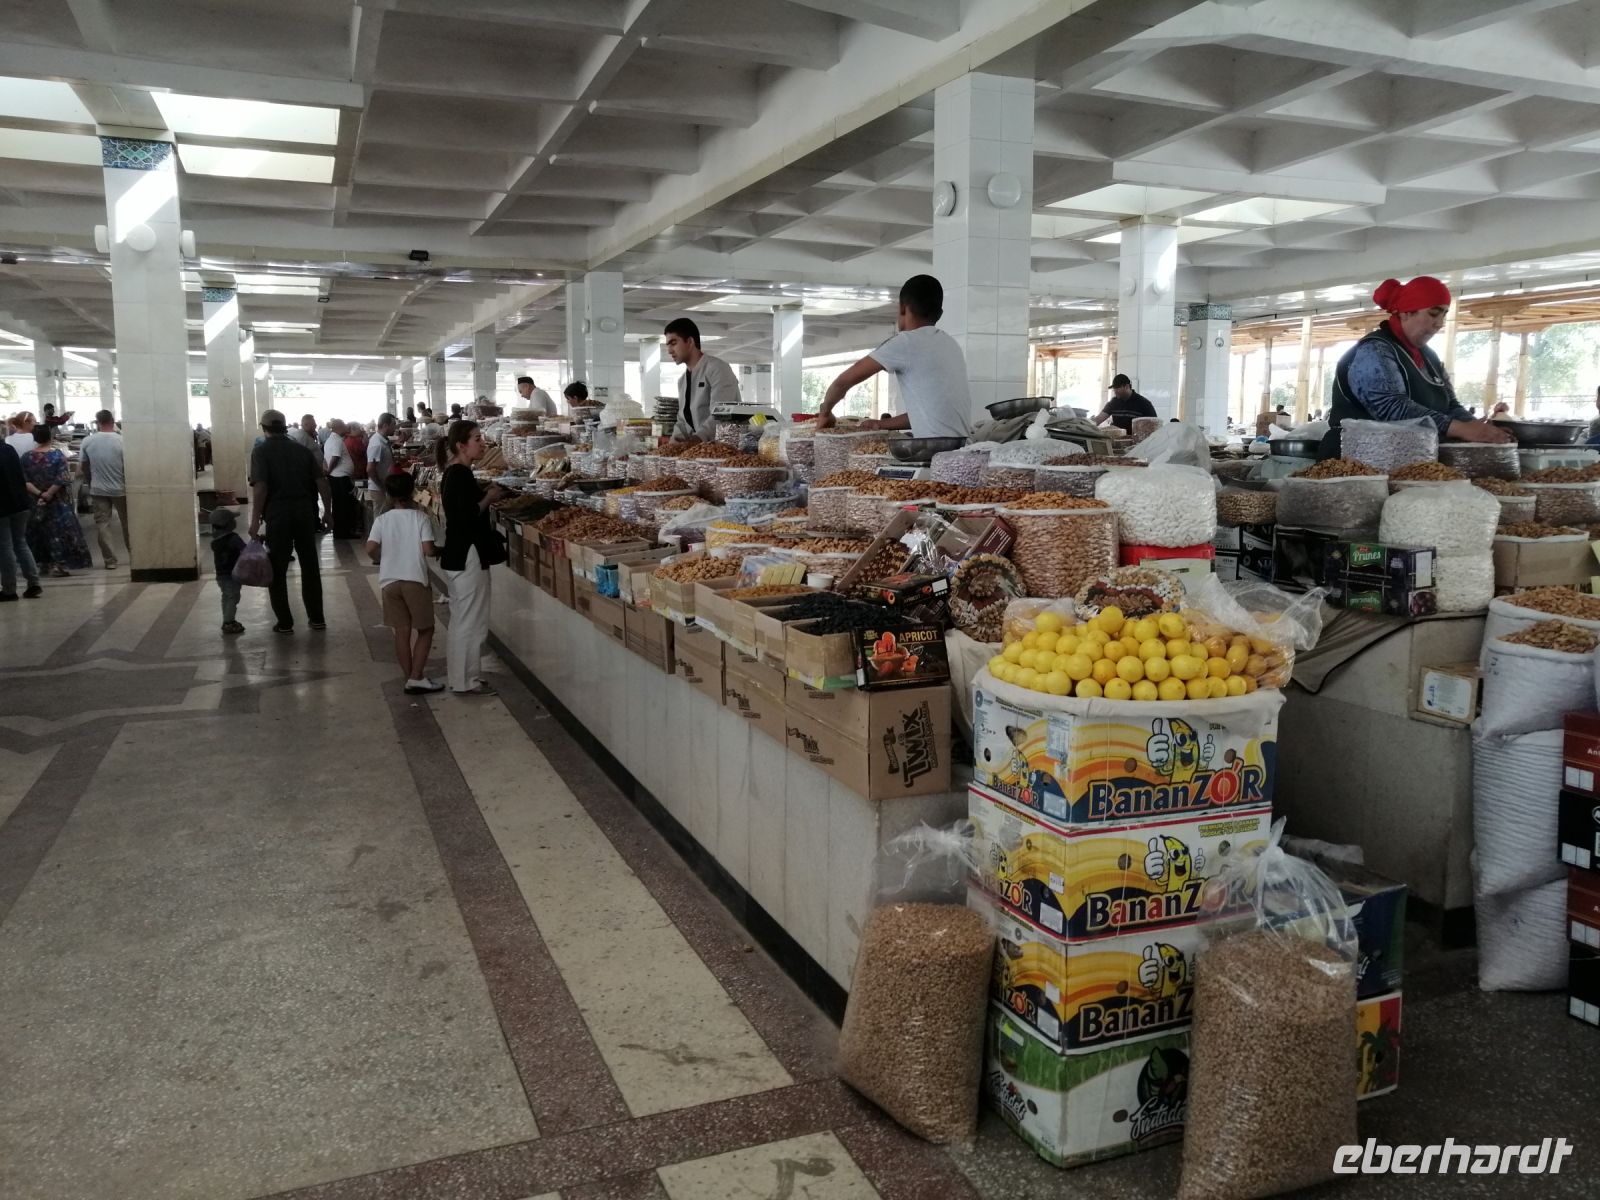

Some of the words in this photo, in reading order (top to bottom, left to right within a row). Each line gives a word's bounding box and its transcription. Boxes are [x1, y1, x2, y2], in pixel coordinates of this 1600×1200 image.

[1353, 551, 1381, 561] Prunes
[900, 630, 938, 642] APRICOT
[1079, 986, 1194, 1040] BananZ
